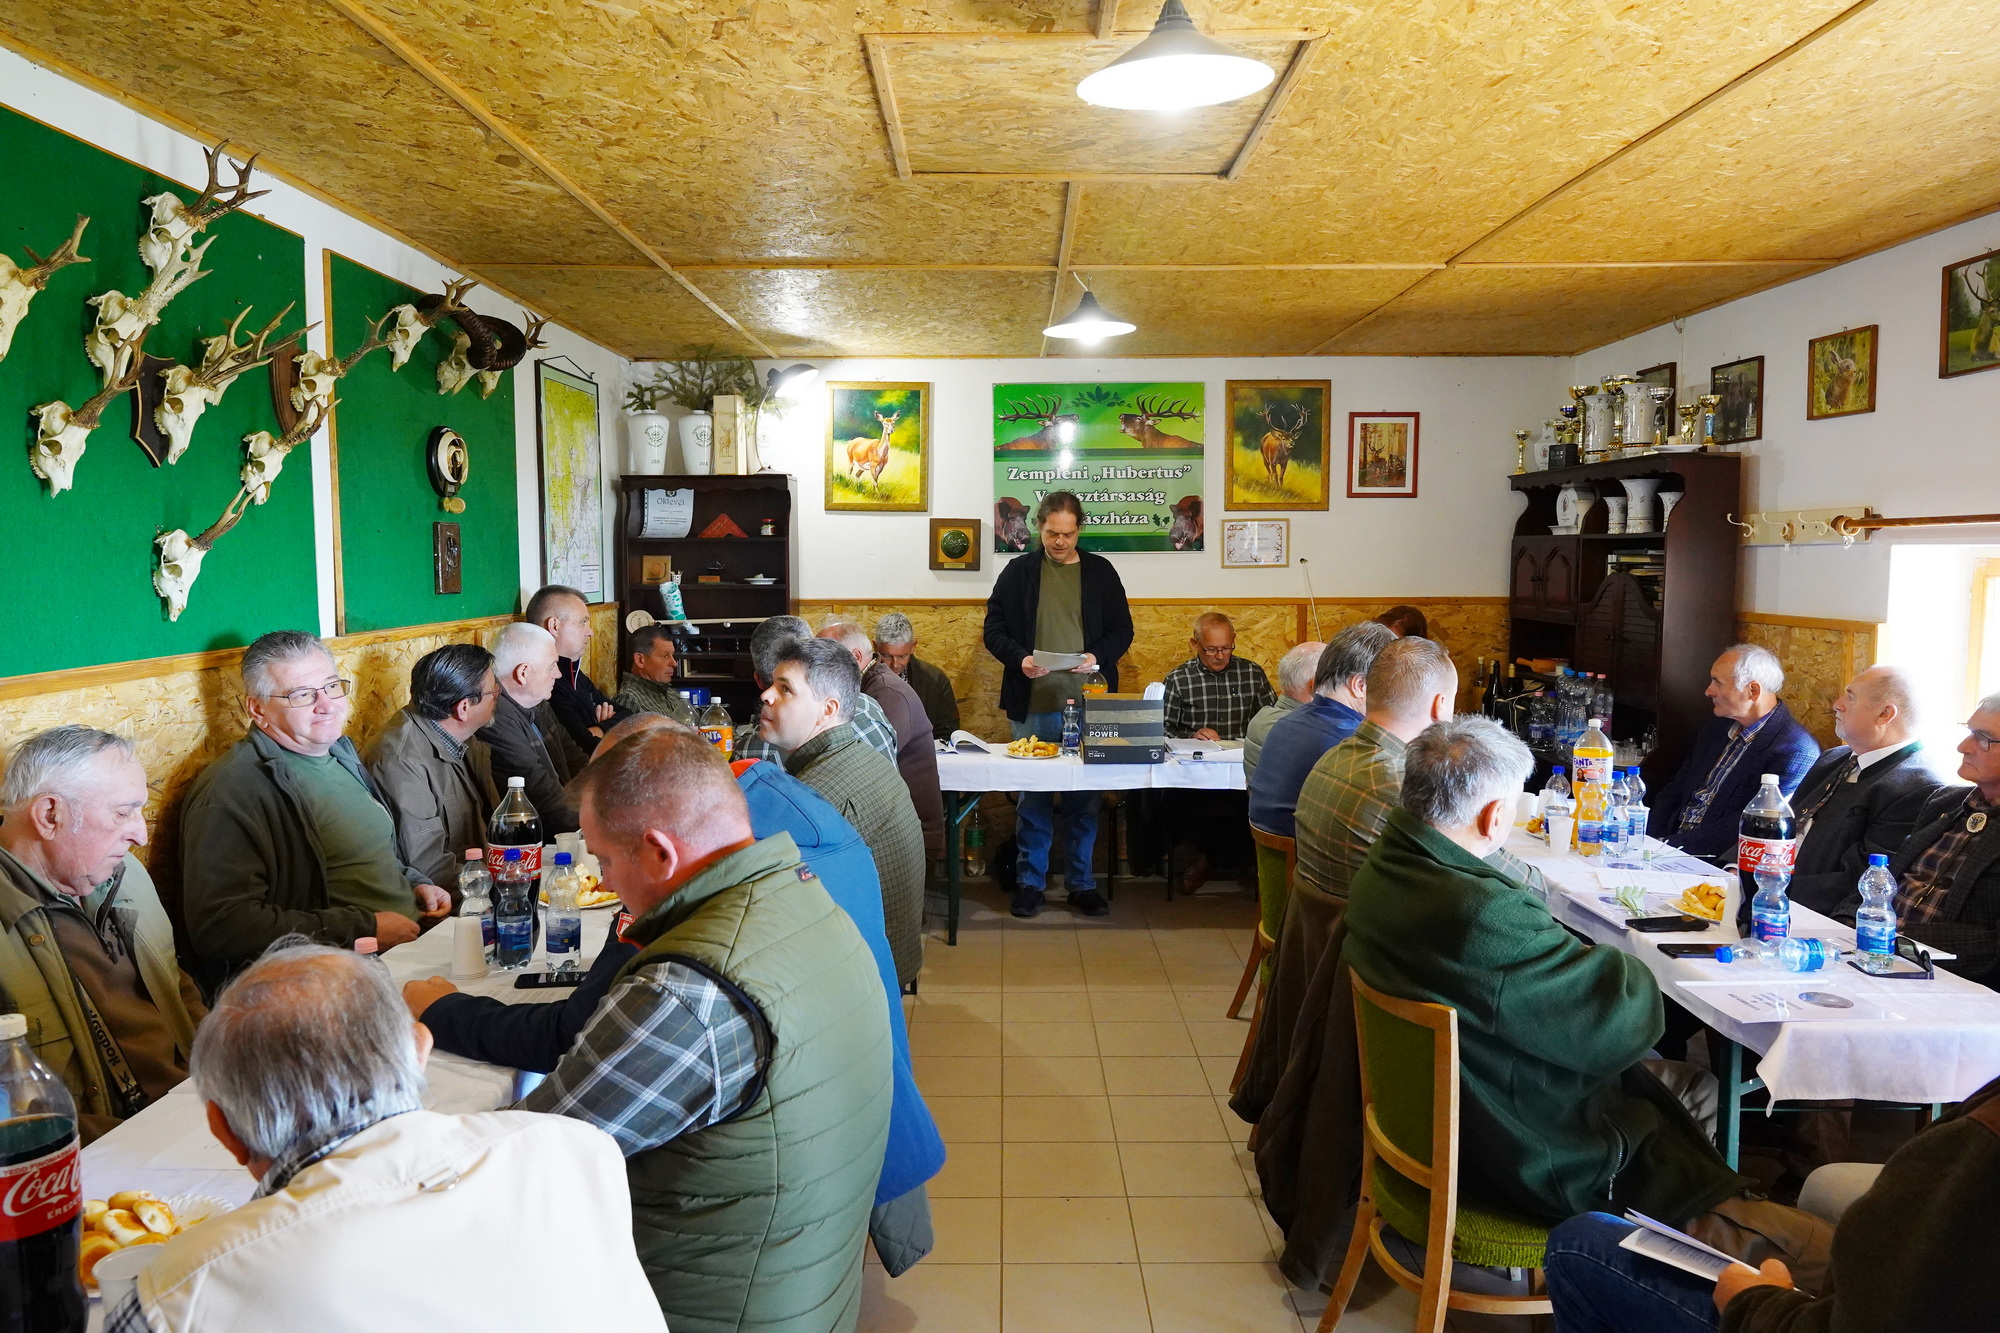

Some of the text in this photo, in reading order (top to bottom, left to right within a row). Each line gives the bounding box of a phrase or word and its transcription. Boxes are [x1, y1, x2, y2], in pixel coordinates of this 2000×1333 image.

[1033, 488, 1166, 505] Vsztársaság
[1083, 511, 1149, 526] ászháza
[701, 730, 722, 740] ANTA
